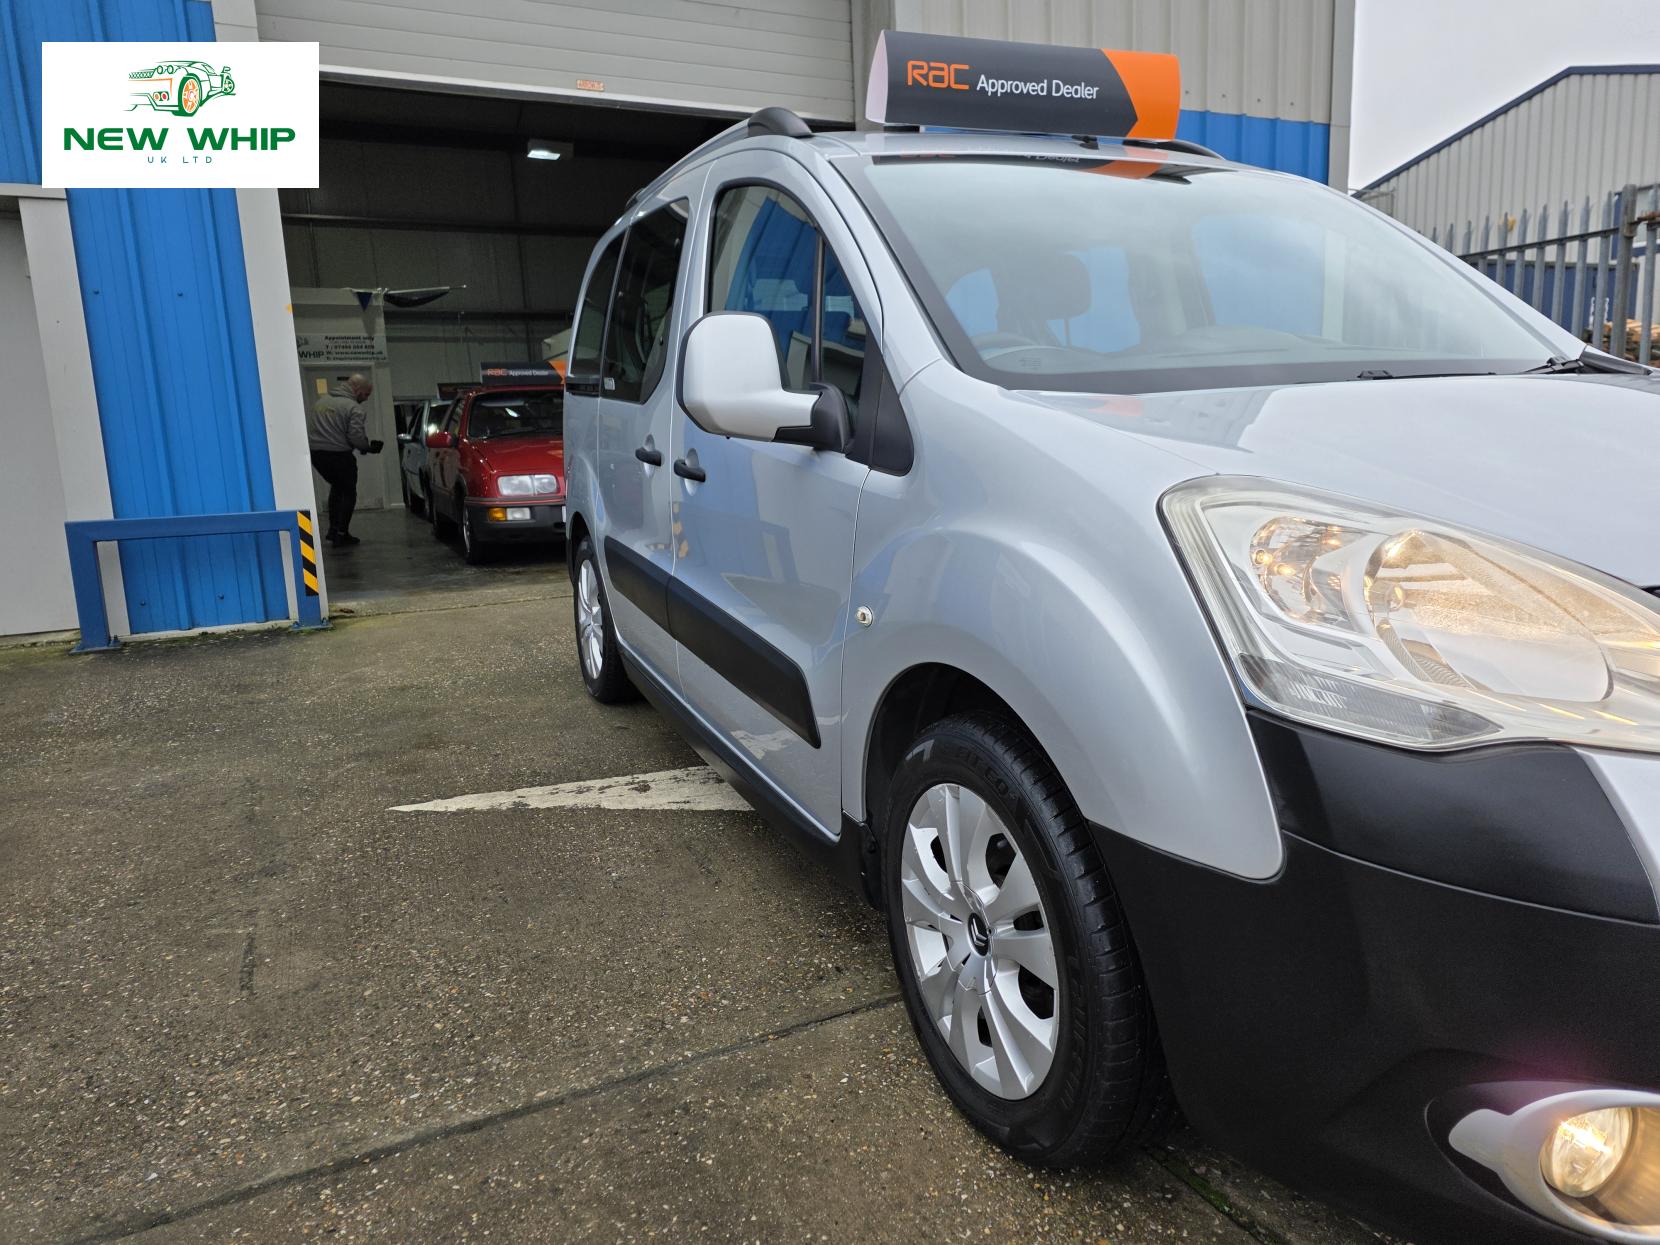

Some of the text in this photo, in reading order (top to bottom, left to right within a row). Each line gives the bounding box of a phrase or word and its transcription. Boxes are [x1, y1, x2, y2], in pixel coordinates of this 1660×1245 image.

[976, 73, 1047, 97] Approved
[1051, 79, 1099, 100] Dealer
[298, 350, 324, 358] WHIP
